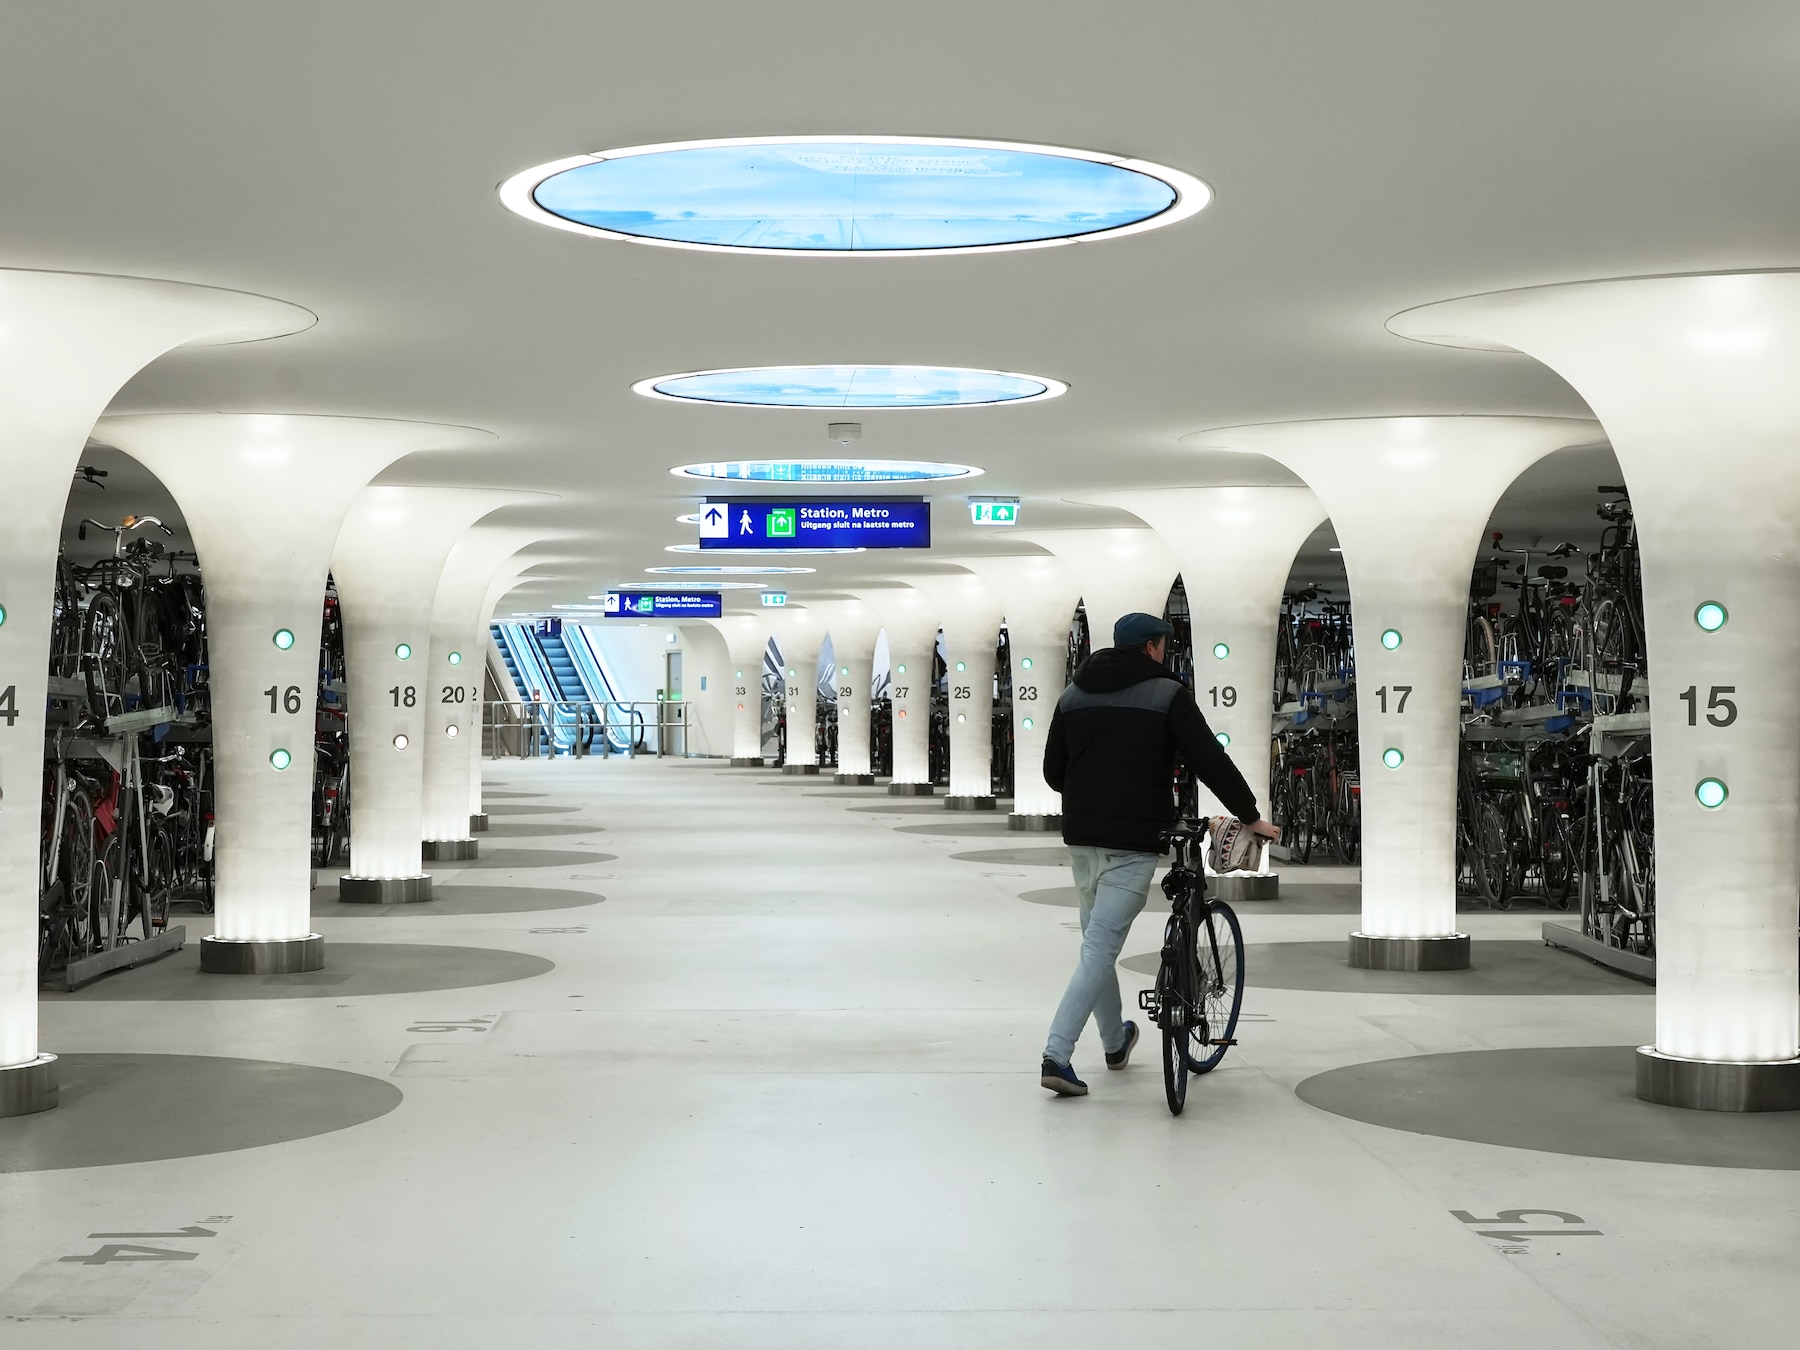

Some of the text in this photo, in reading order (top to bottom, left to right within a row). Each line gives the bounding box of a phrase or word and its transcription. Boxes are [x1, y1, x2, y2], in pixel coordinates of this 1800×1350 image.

[800, 507, 848, 520] Station,
[852, 507, 889, 518] Metro
[800, 520, 832, 531] Uitgang
[833, 520, 850, 529] sluit
[863, 520, 890, 529] laatste
[891, 521, 915, 529] metro
[389, 685, 416, 708] 18
[441, 685, 465, 704] 20
[735, 686, 746, 696] 33
[788, 686, 799, 697] 31
[839, 686, 852, 697] 29
[895, 686, 910, 699] 27
[954, 686, 971, 700] 25
[1018, 686, 1038, 701] 23
[1208, 685, 1237, 708] 19
[263, 685, 301, 715] 16
[1375, 685, 1413, 714] 17
[1679, 685, 1738, 728] 15
[405, 1018, 493, 1033] 16
[1447, 1209, 1605, 1243] 15
[57, 1225, 218, 1266] 14
